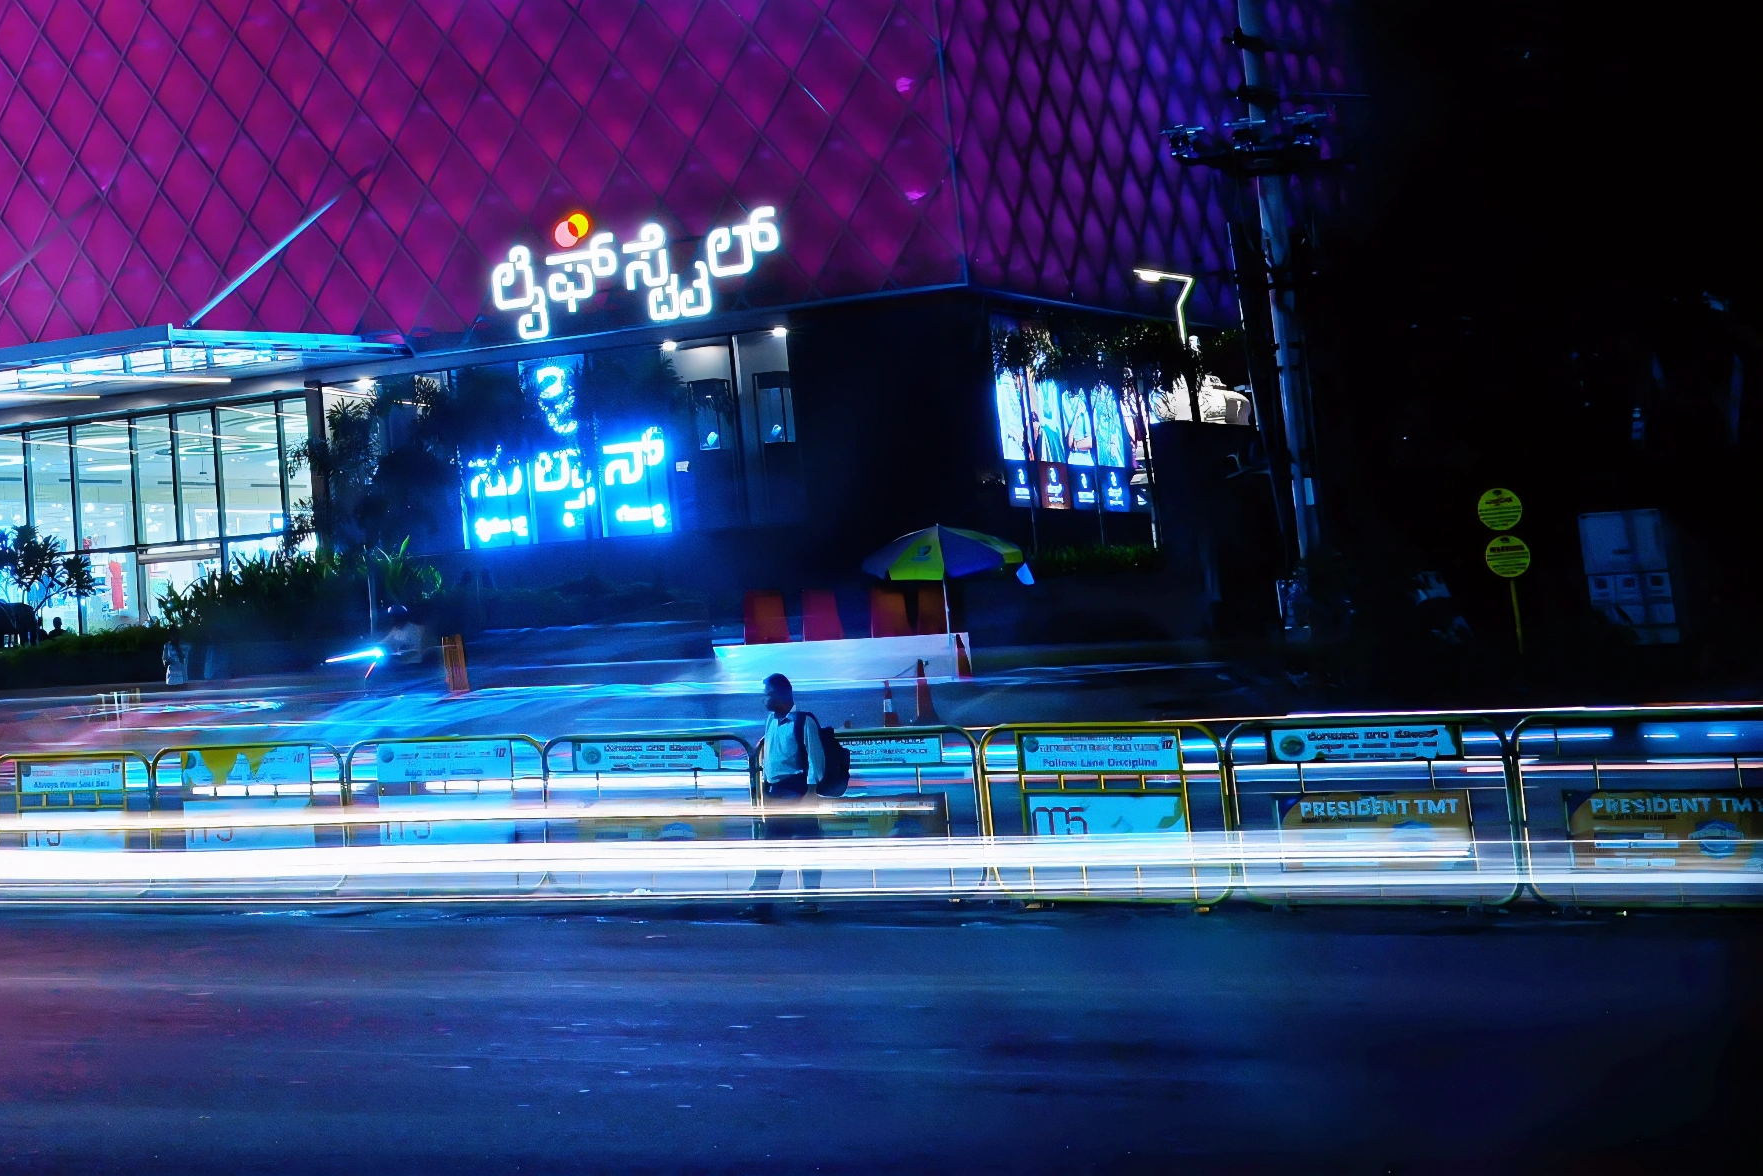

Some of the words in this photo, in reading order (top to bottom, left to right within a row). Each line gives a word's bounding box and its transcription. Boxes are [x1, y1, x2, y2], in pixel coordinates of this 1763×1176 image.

[1042, 758, 1076, 767] Follow
[1080, 758, 1104, 767] Lane
[1108, 757, 1158, 769] Discipline
[1299, 799, 1410, 817] PRESIDENT
[1414, 798, 1459, 815] TMT
[1590, 797, 1712, 813] PRESIDENT
